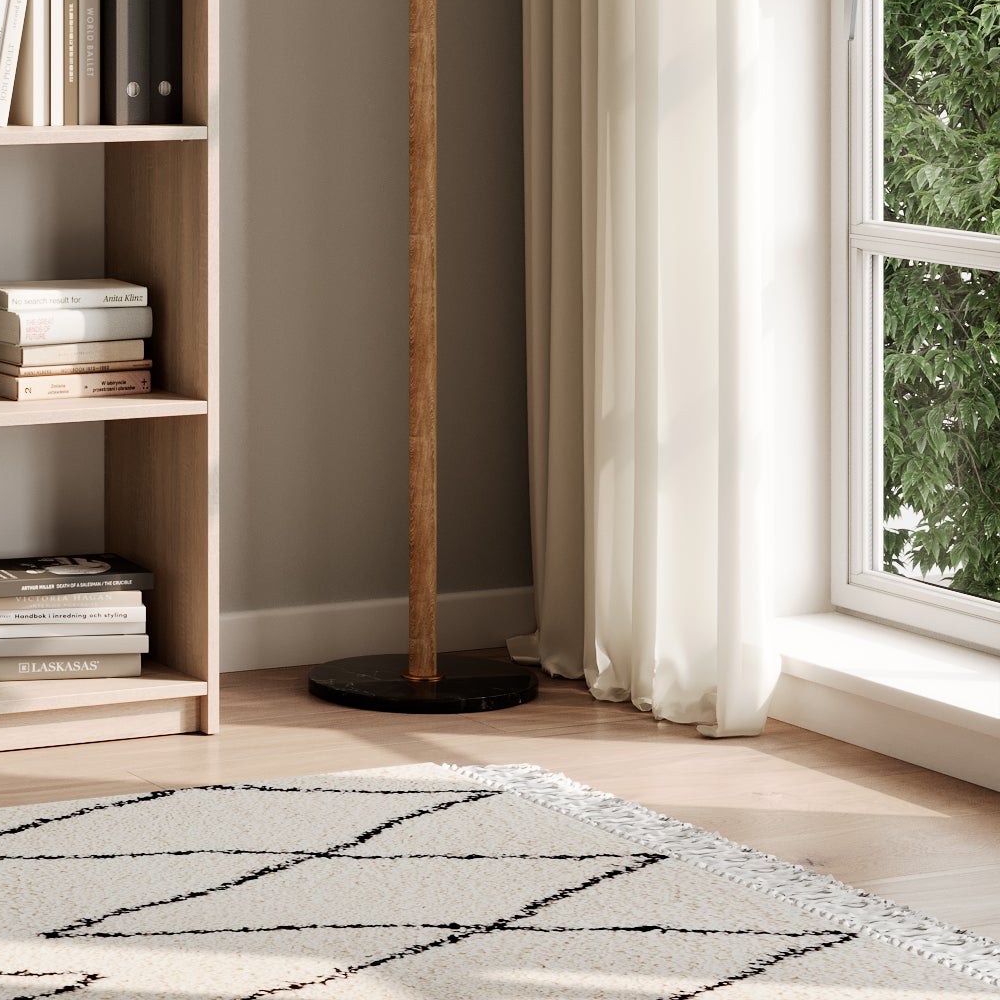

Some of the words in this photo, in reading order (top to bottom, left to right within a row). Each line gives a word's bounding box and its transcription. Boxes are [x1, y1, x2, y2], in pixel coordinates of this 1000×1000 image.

[86, 7, 95, 40] WORLD
[86, 45, 94, 77] BALLET
[50, 296, 69, 304] result
[103, 295, 123, 303] Anita
[124, 294, 144, 302] Klinz
[53, 612, 87, 620] inredning
[104, 611, 128, 619] styling
[31, 660, 98, 673] LASKASAS
